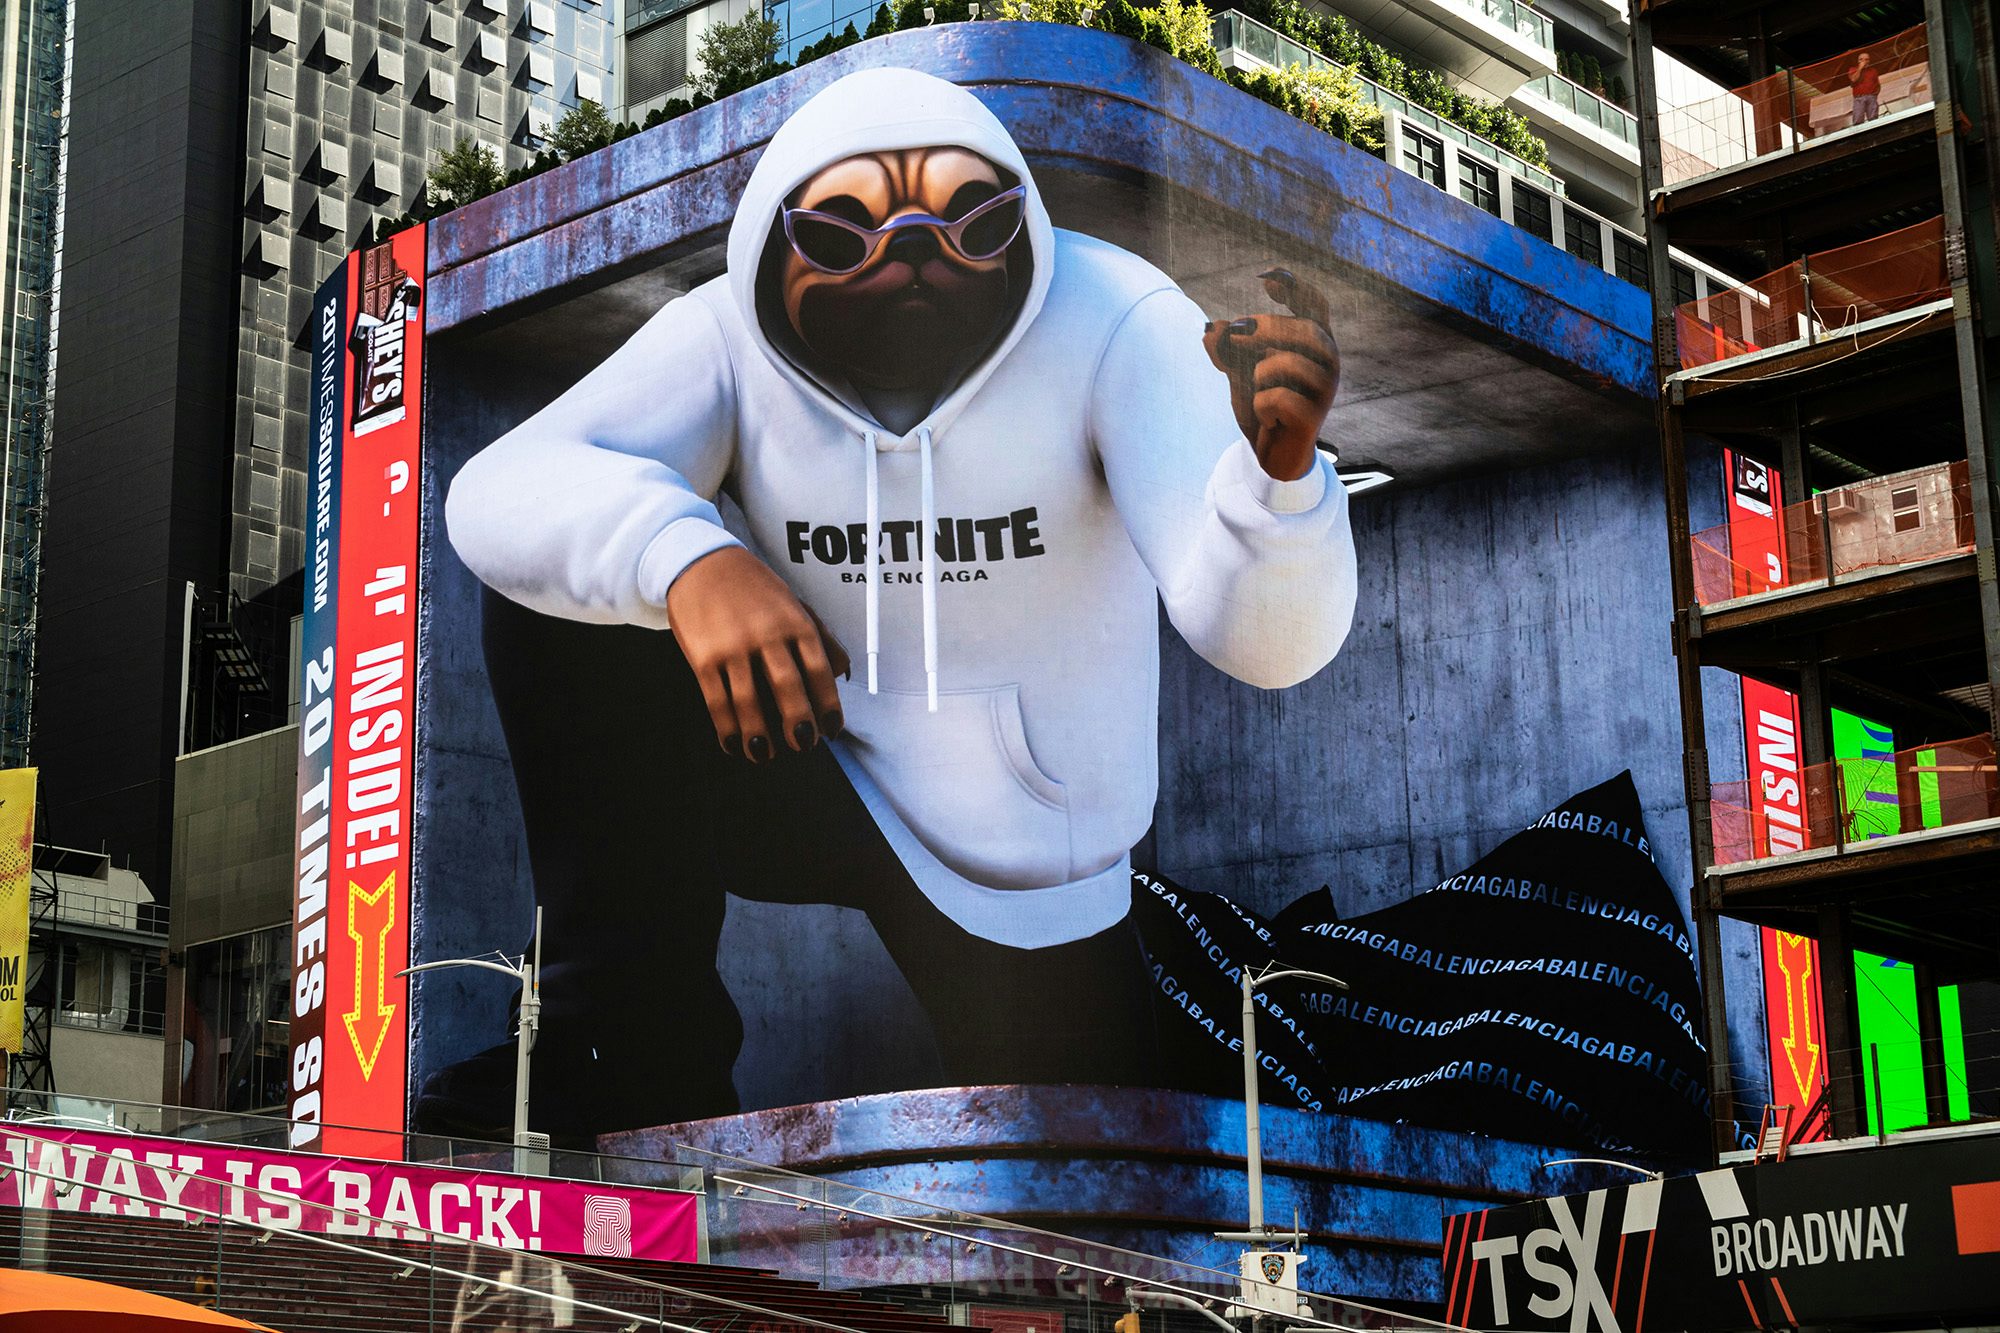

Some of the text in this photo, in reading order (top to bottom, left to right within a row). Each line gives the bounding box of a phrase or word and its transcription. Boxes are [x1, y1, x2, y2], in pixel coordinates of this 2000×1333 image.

[786, 506, 1045, 565] FORTNITE
[841, 569, 988, 584] BAENCAGA
[304, 645, 333, 758] 20
[345, 640, 404, 870] INSIDE!
[294, 764, 330, 1018] TIMES
[6, 1138, 541, 1251] WAY IS BACK!
[1711, 1203, 1909, 1277] BROADWAY
[1472, 1188, 1621, 1333] TSX
